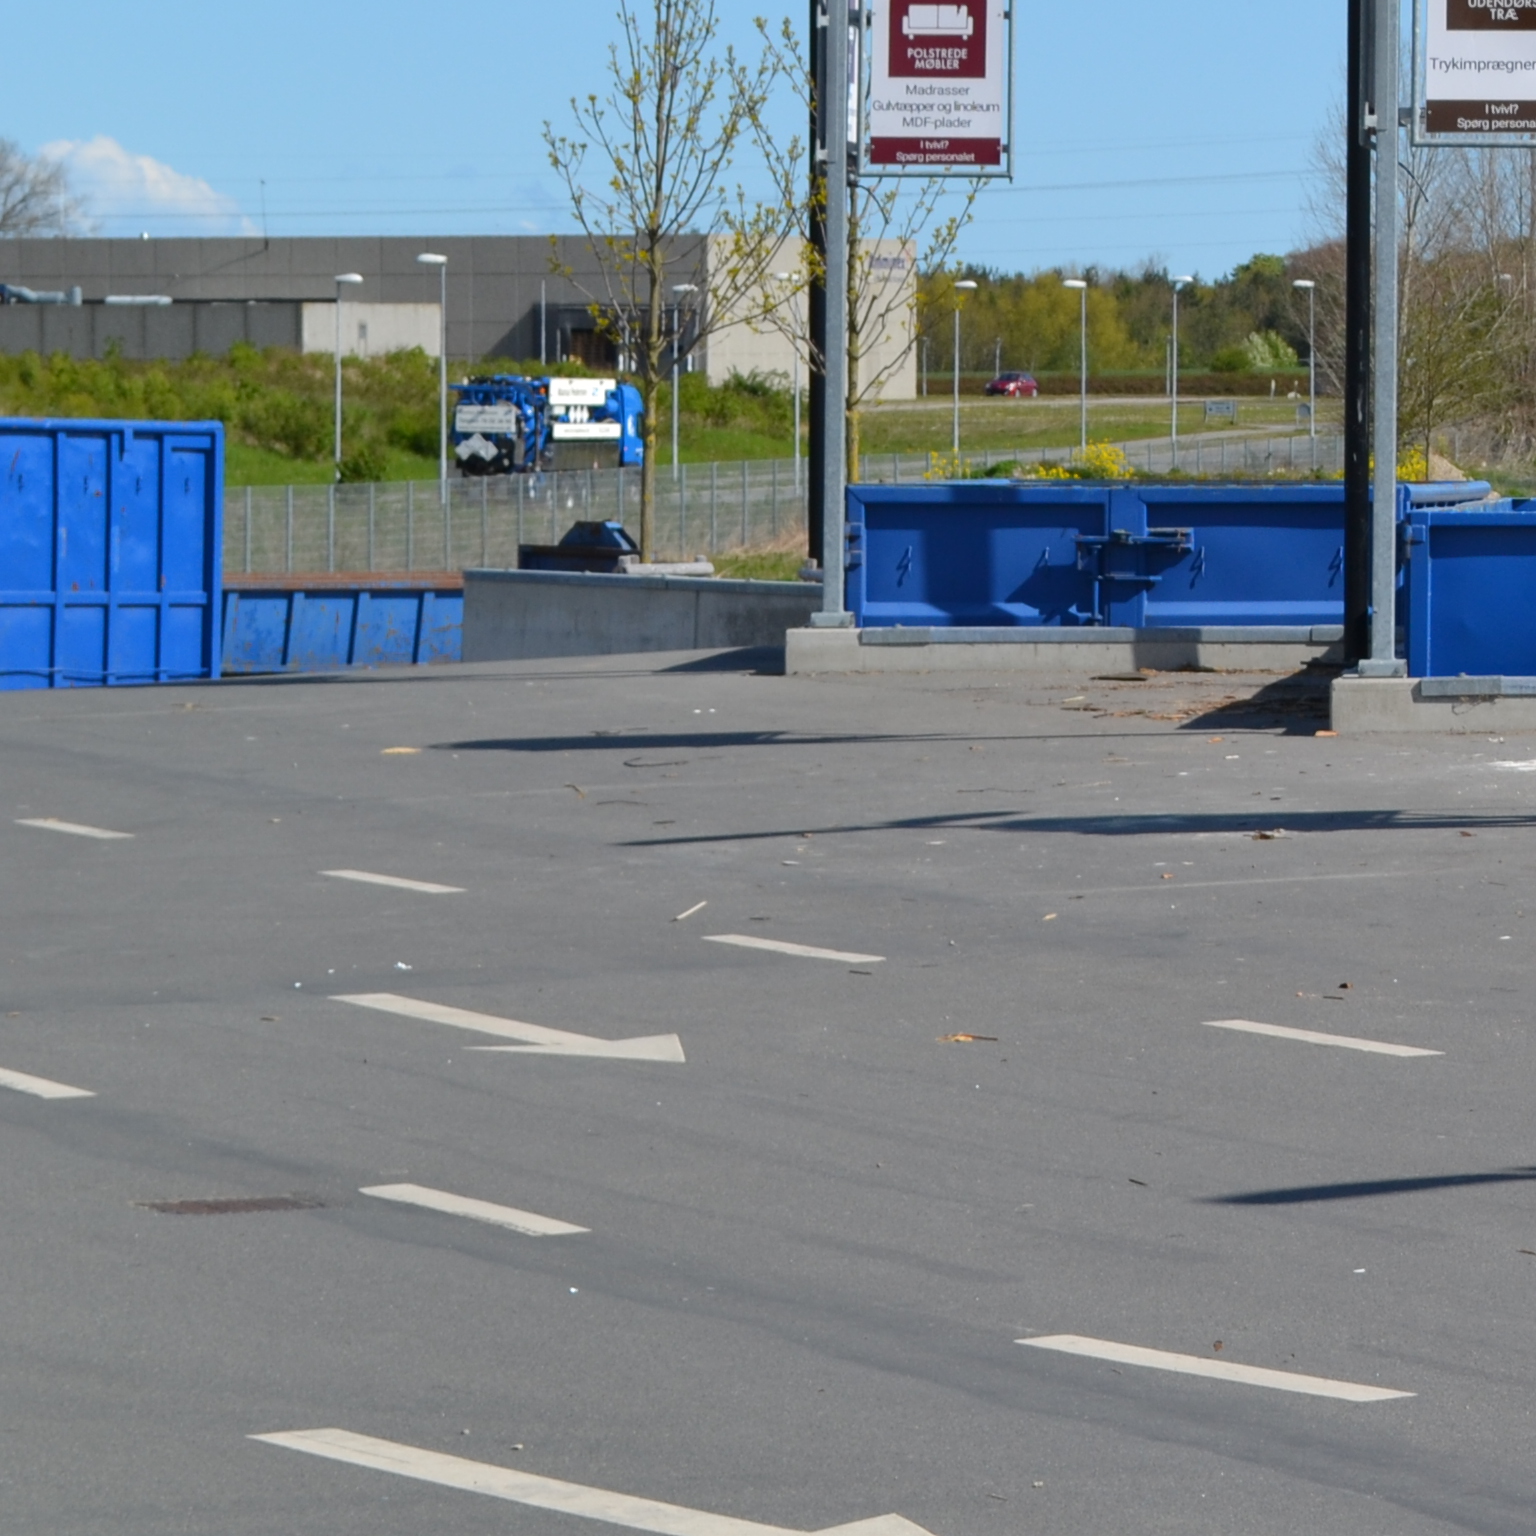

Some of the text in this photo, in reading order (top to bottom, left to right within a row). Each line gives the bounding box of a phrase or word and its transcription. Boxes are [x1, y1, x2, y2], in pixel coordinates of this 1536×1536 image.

[1489, 8, 1519, 20] TRÆ
[907, 48, 968, 59] POLSTREDE
[914, 59, 959, 70] MØBLER
[905, 84, 970, 95] Madrasser
[873, 100, 1000, 114] Gulvtæpper og linoleum
[1485, 103, 1519, 114] I tvivl?
[902, 116, 972, 130] MDF-plader
[1457, 117, 1489, 130] Spørg
[896, 151, 975, 162] Spørg personalet
